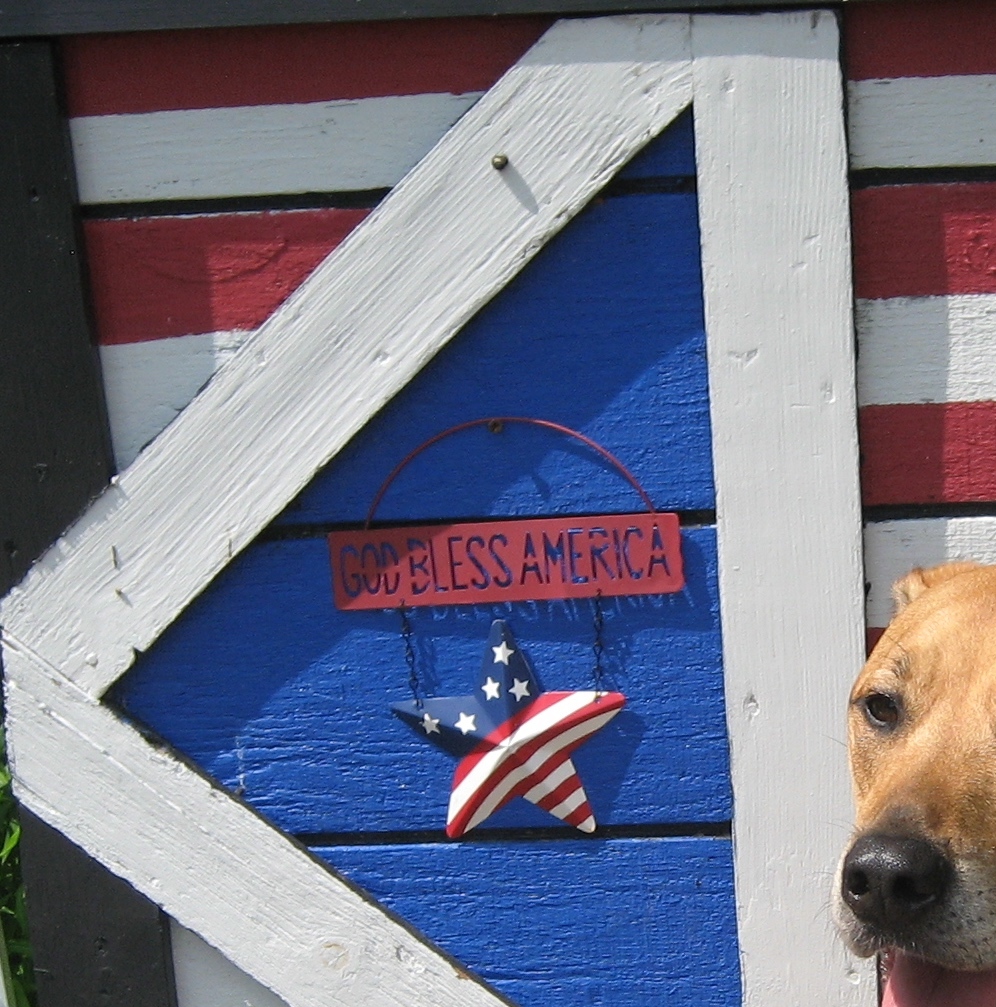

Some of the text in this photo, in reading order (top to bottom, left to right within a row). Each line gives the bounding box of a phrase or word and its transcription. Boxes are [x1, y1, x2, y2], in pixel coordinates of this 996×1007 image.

[340, 524, 671, 598] GOD BLESS AMERICA
